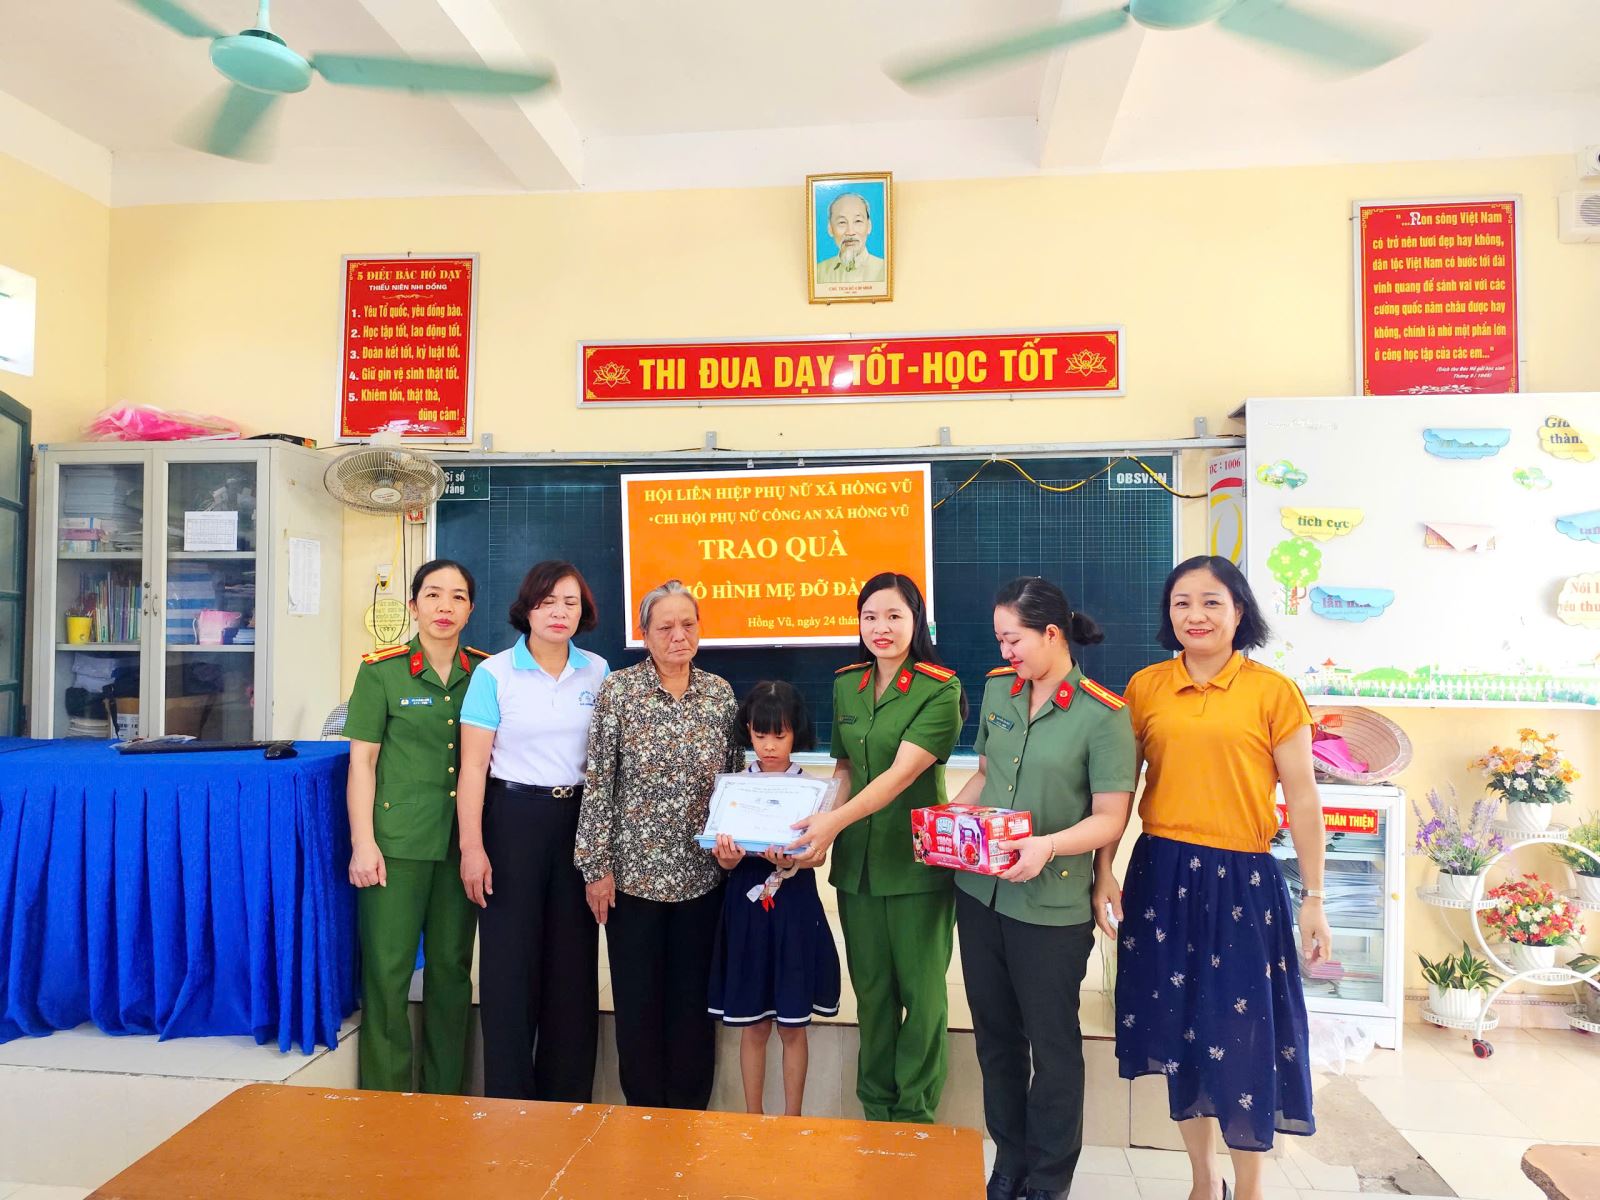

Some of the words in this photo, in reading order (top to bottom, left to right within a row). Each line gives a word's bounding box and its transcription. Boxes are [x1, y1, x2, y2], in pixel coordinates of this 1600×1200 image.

[1436, 213, 1457, 225] sông
[1460, 212, 1478, 226] Việt
[1481, 212, 1502, 223] Nam
[1373, 237, 1383, 249] có
[1402, 236, 1417, 248] nên
[1420, 235, 1436, 247] tươi
[1439, 235, 1454, 249] đẹp
[1457, 234, 1472, 247] hay
[1475, 233, 1504, 247] không,
[1373, 259, 1387, 270] dân
[1391, 258, 1403, 272] tộc
[1406, 257, 1421, 271] Việt
[1424, 257, 1442, 268] Nam
[1445, 256, 1455, 267] có
[1458, 255, 1477, 267] bước
[358, 272, 363, 280] 5
[396, 268, 417, 280] BÁC
[440, 270, 461, 281] DẠY
[1374, 282, 1392, 293] vinh
[1395, 282, 1420, 294] quang
[1424, 277, 1434, 292] để
[1436, 280, 1456, 291] sánh
[1460, 279, 1472, 291] vai
[1475, 278, 1487, 290] với
[1490, 278, 1505, 290] các
[352, 309, 360, 318] 1.
[364, 305, 377, 317] Yêu
[380, 302, 388, 317] Tổ
[390, 302, 409, 318] quốc,
[412, 304, 424, 318] yêu
[1402, 300, 1422, 315] quốc
[1425, 302, 1442, 313] năm
[1446, 301, 1465, 312] châu
[1468, 301, 1488, 315] được
[1491, 301, 1505, 313] hay
[351, 329, 360, 338] 2.
[363, 325, 378, 340] Học
[381, 325, 393, 340] tập
[396, 323, 408, 338] tốt,
[411, 325, 423, 337] lao
[426, 324, 446, 339] động
[448, 322, 461, 337] tốt.
[1404, 325, 1425, 337] chính
[1455, 324, 1470, 338] một
[350, 350, 359, 359] 3.
[385, 344, 398, 358] kết
[401, 344, 413, 359] tốt,
[429, 345, 444, 360] luật
[447, 343, 460, 358] tốt.
[1382, 348, 1401, 361] công
[1404, 348, 1418, 363] học
[1421, 347, 1433, 362] tập
[1436, 346, 1450, 359] của
[1453, 346, 1467, 359] các
[349, 372, 358, 380] 4.
[362, 367, 376, 380] Giữ
[394, 367, 403, 382] vệ
[406, 367, 424, 379] sinh
[427, 367, 443, 382] thật
[446, 365, 459, 379] tốt.
[639, 358, 686, 390] THI
[699, 356, 761, 388] ĐUA
[774, 356, 834, 393] DẠY
[1000, 338, 1058, 382] TỐT
[348, 393, 358, 401] 5.
[361, 388, 387, 401] Khiêm
[407, 388, 423, 403] thật
[418, 408, 437, 422] dũng
[1550, 432, 1583, 444] thàn
[456, 470, 465, 481] số
[645, 488, 672, 504] HỘI
[677, 486, 711, 500] LIÊN
[716, 486, 751, 501] HIỆP
[755, 486, 784, 500] PHỤ
[790, 482, 812, 497] NỮ
[816, 482, 837, 496] XÃ
[841, 480, 886, 495] HỒNG
[890, 478, 912, 493] VŨ
[682, 512, 706, 525] HỘI
[710, 512, 736, 524] PHỤ
[740, 509, 760, 521] NỮ
[762, 508, 800, 521] CÔNG
[804, 510, 821, 520] AN
[825, 506, 844, 519] XÃ
[847, 505, 887, 518] HỒNG
[890, 504, 909, 517] VŨ
[698, 538, 778, 560] TRAO
[785, 530, 848, 562] QUÀ
[712, 580, 760, 599] HÌNH
[766, 582, 795, 601] MẸ
[800, 578, 829, 597] ĐỠ
[833, 577, 866, 596] ĐẦ
[748, 615, 774, 629] Hồng
[777, 616, 794, 627] Vũ,
[798, 616, 820, 628] ngày
[823, 616, 835, 626] 24
[839, 616, 859, 625] thán
[1324, 813, 1346, 826] THÂN
[1349, 814, 1374, 830] THIỆN
